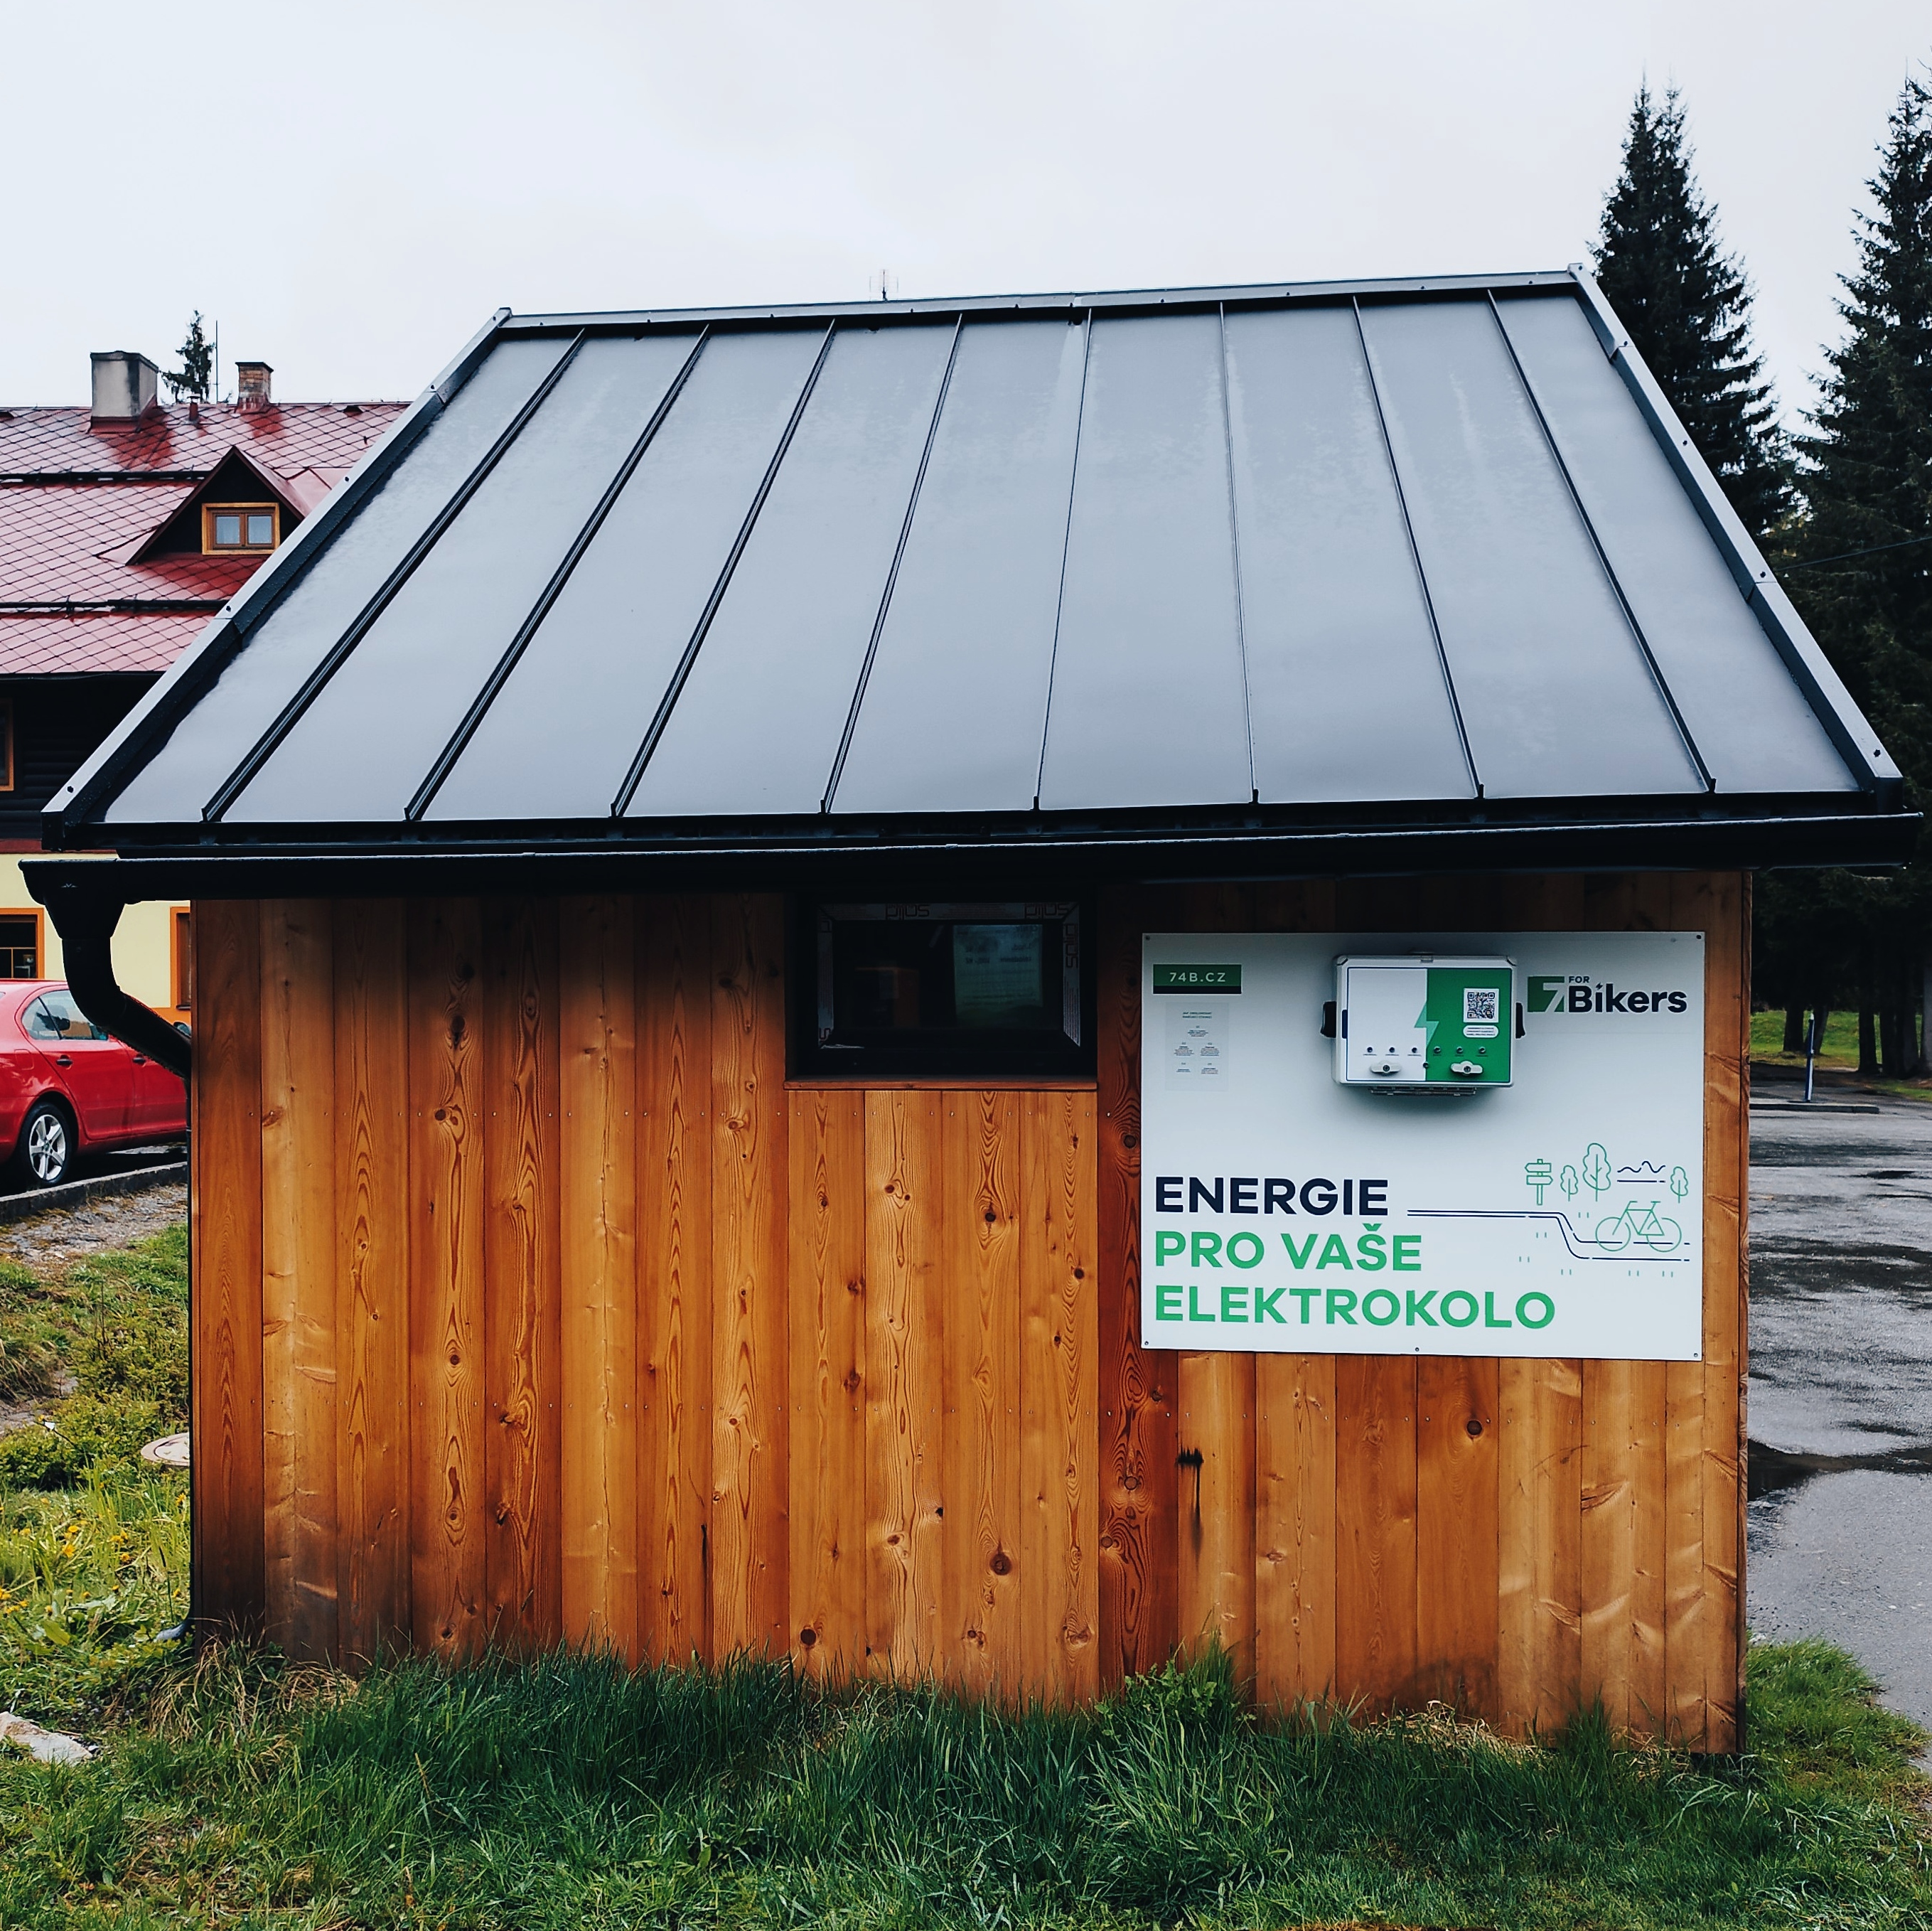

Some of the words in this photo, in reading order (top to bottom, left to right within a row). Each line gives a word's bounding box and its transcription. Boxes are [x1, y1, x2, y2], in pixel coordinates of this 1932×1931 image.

[1169, 972, 1226, 983] 74B.CZ
[1568, 983, 1687, 1013] Bikers
[1156, 1177, 1388, 1216] ENERGIE
[1156, 1231, 1265, 1268] PRO
[1281, 1224, 1422, 1271] VAŠE
[1156, 1285, 1555, 1329] ELEKTROKOLO
